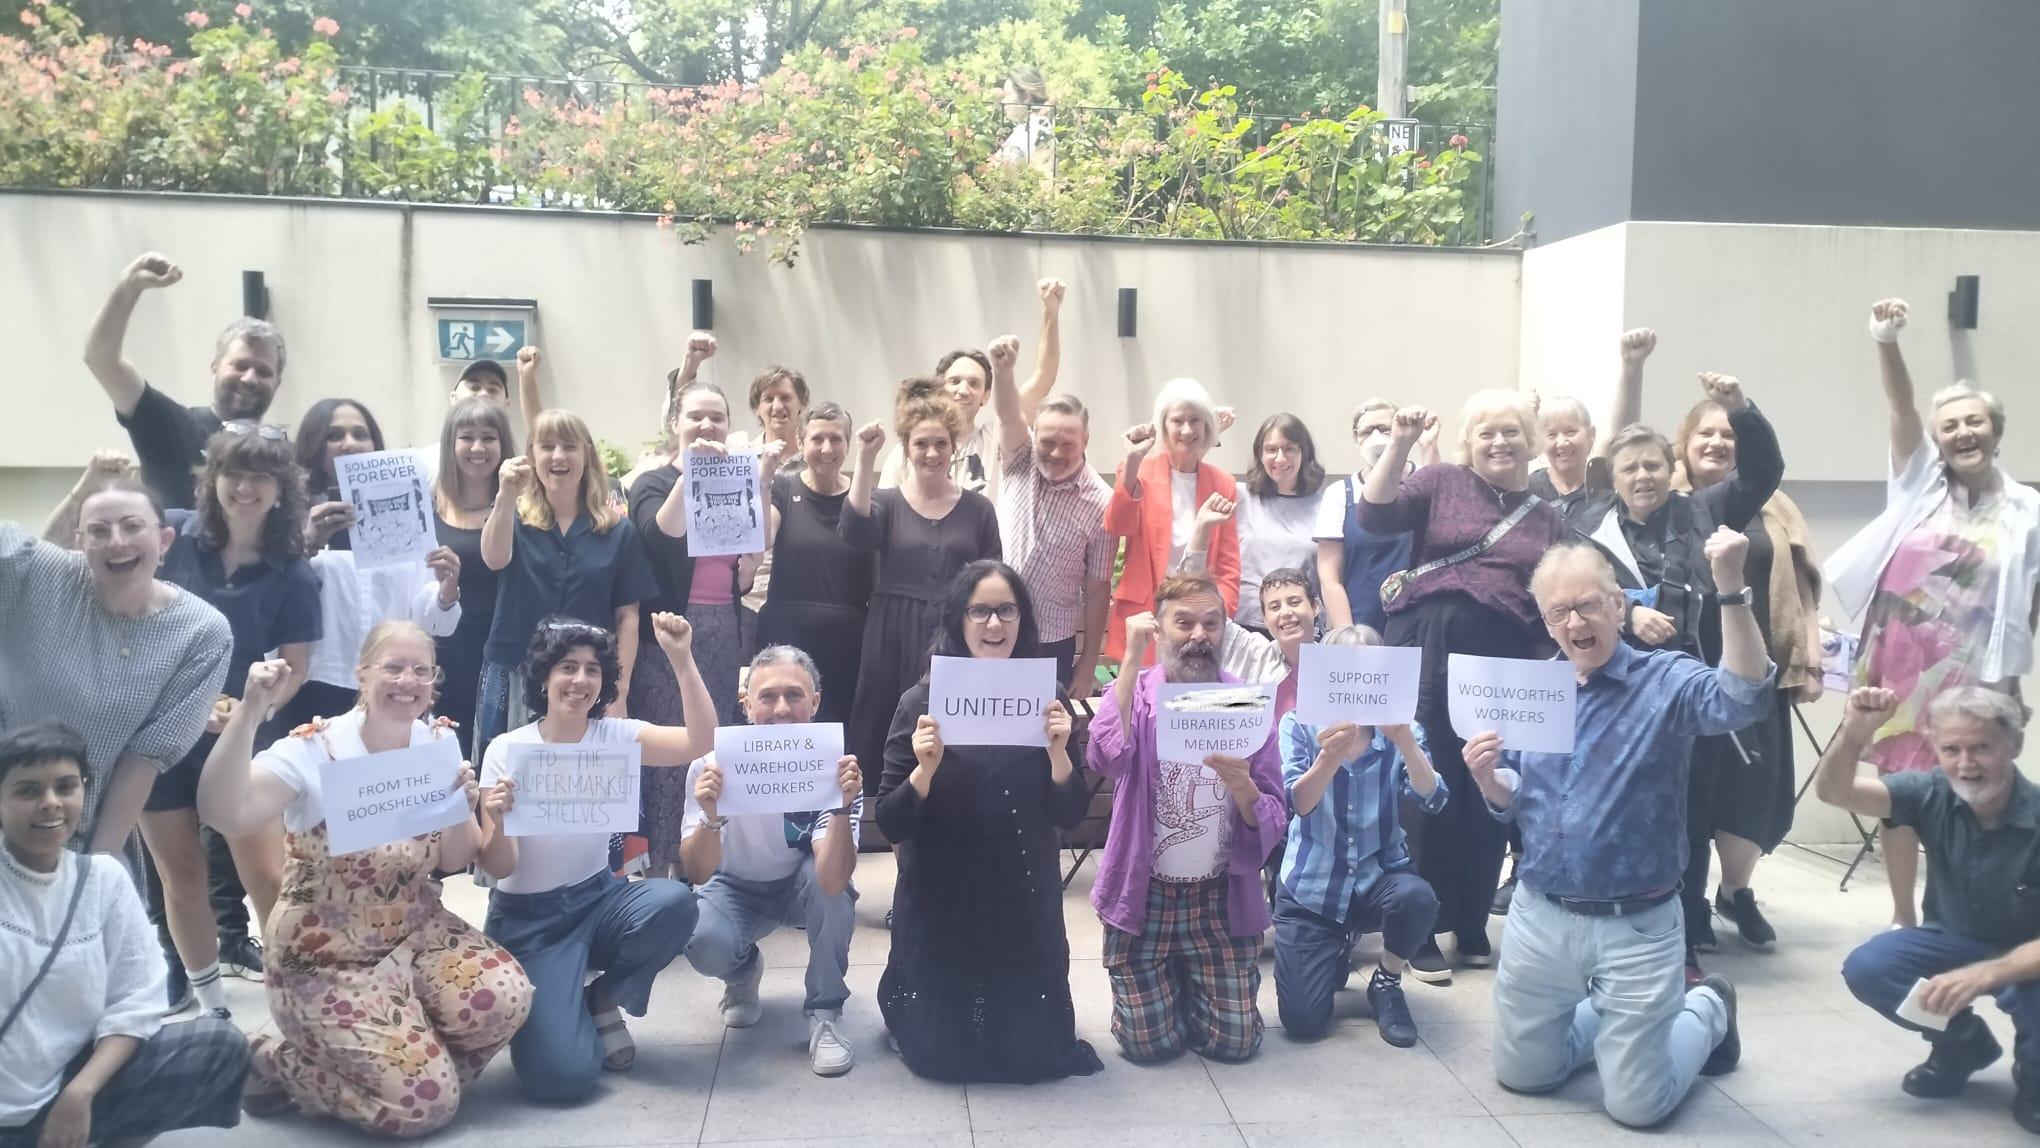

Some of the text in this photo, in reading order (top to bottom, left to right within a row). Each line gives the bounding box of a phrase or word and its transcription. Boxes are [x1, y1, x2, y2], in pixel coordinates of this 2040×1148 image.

[344, 455, 413, 474] SOLIDARITY
[690, 455, 752, 466] SOLIDARITY
[347, 465, 417, 485] FOREVER
[691, 465, 752, 478] FOREVER
[1329, 671, 1390, 684] SUPPORT
[1328, 692, 1388, 705] STRIKING
[1458, 683, 1565, 702] WOOLWORTHS
[945, 697, 1040, 716] UNITED!
[1170, 716, 1263, 730] LIBRARIES ASU
[1475, 707, 1545, 723] WORKERS
[744, 737, 815, 752] LIBRARY &
[1184, 738, 1249, 751] MEMBERS
[533, 748, 608, 768] TO THE
[735, 760, 825, 774] WAREHOUSE
[358, 773, 432, 798] FROM THE
[512, 772, 638, 796] SUPERMARKET
[746, 780, 815, 795] WORKERS
[347, 789, 447, 821] BOOKSHELVES
[533, 801, 610, 827] SHELVES
